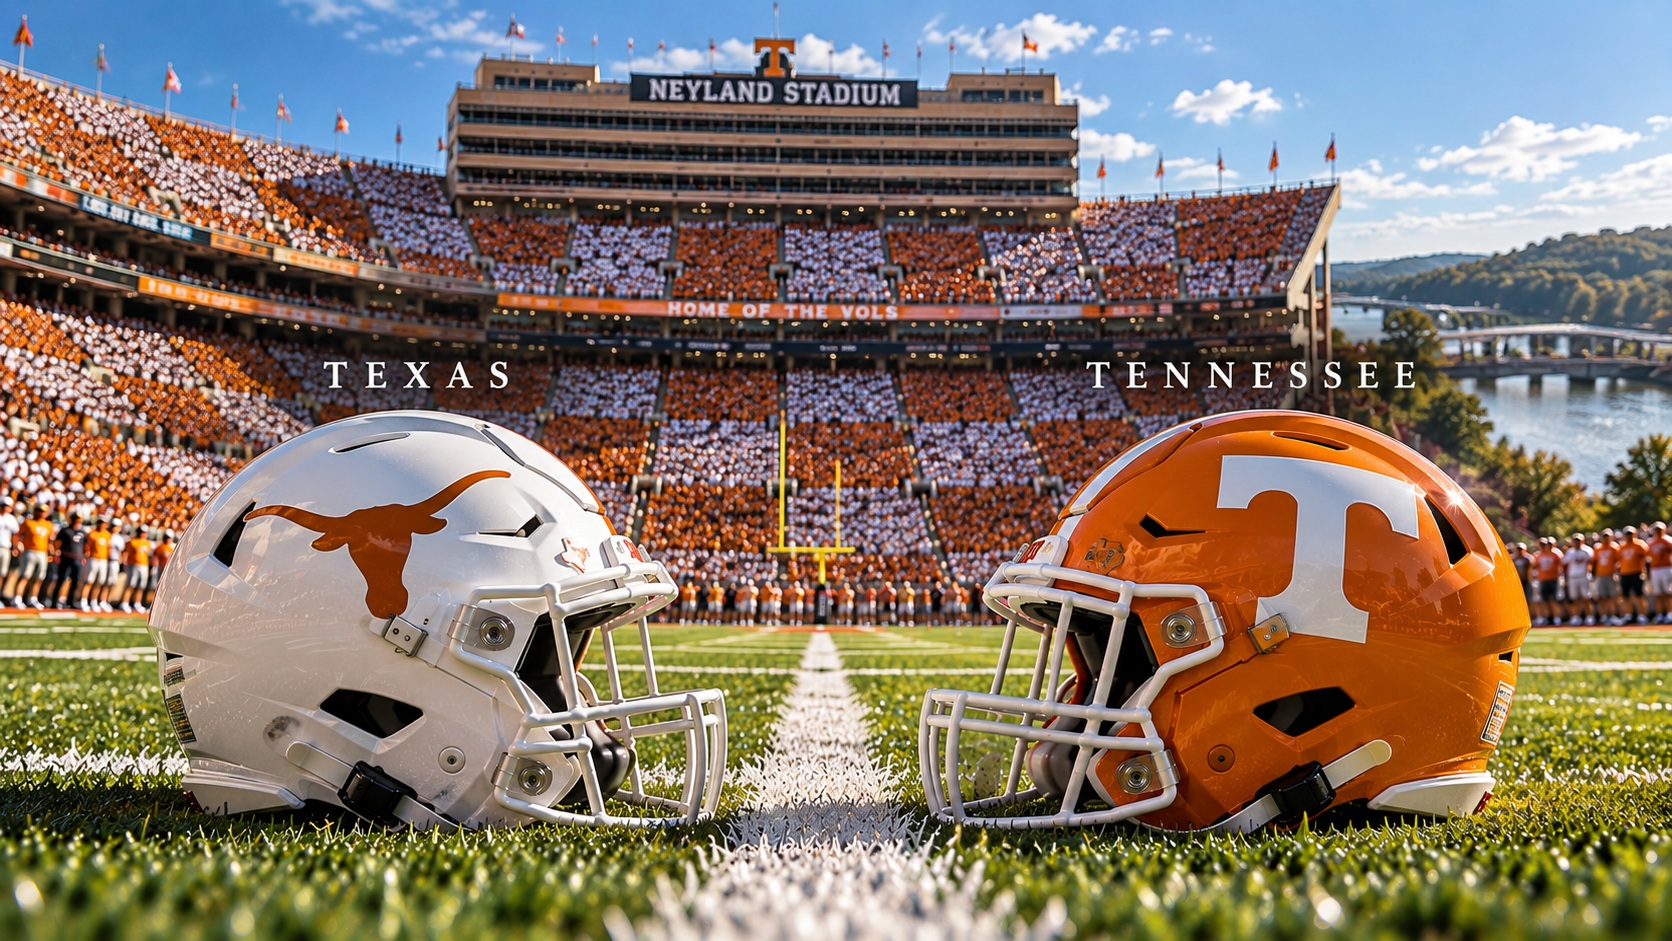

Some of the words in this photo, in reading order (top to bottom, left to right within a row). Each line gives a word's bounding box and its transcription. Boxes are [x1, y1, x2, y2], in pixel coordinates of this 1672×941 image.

[754, 38, 796, 77] T
[649, 79, 774, 103] NEYLAND
[783, 82, 901, 106] STADIUM
[667, 302, 730, 317] HOME
[742, 304, 771, 318] OF
[784, 305, 828, 319] THE
[841, 306, 898, 319] VOLS
[1217, 454, 1419, 644] T
